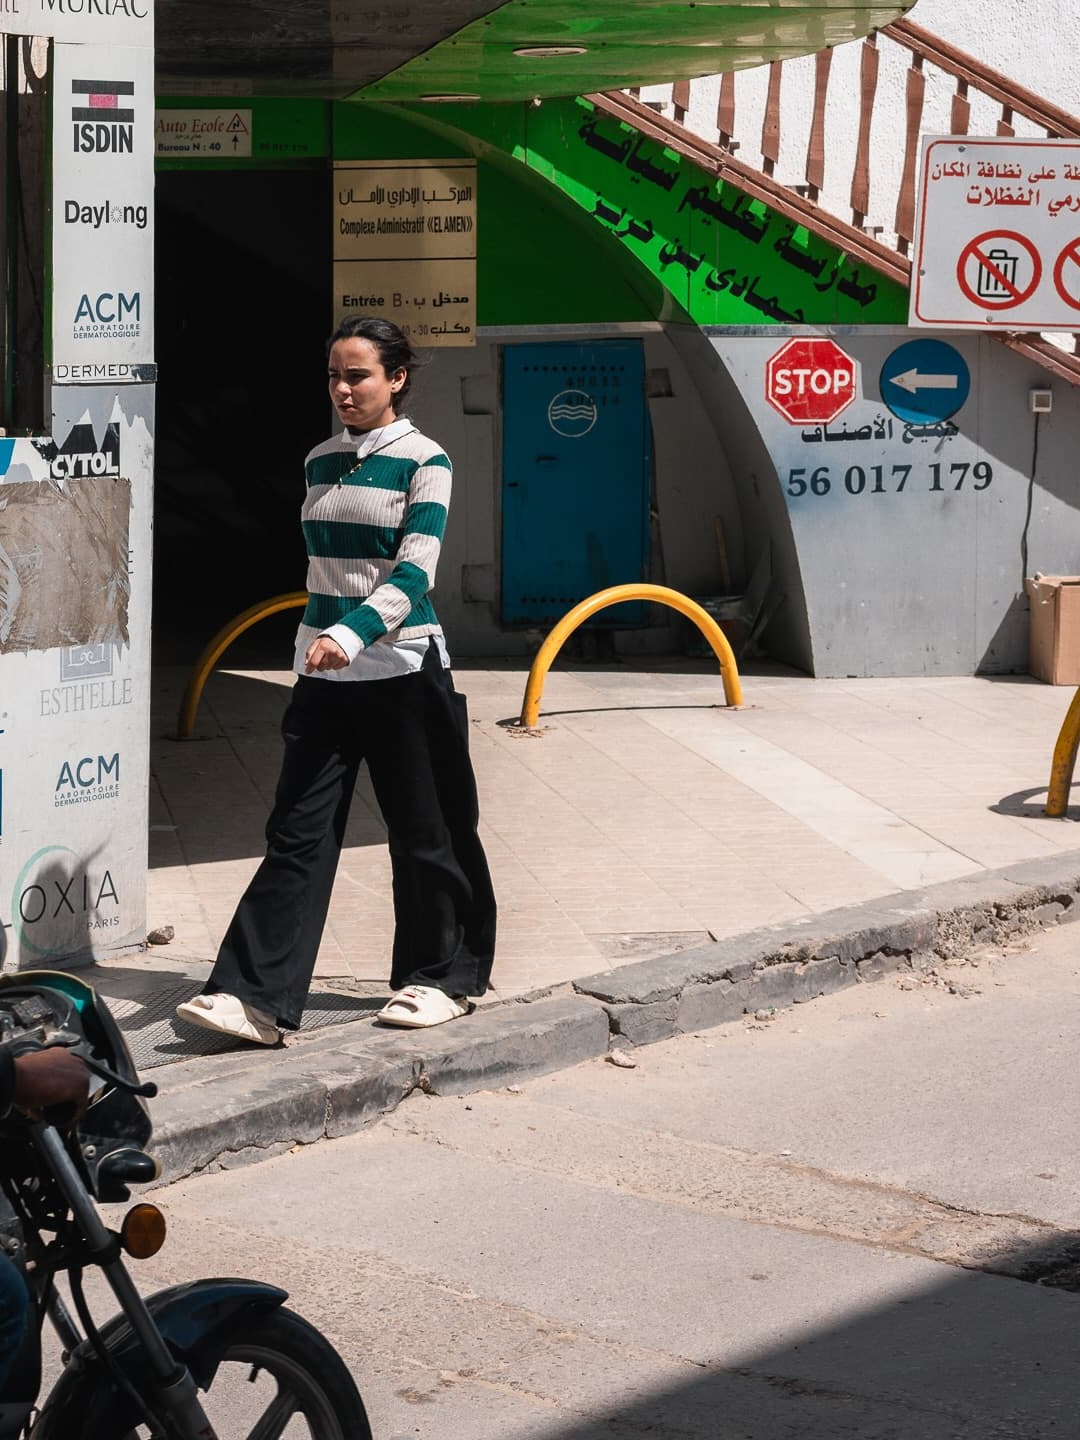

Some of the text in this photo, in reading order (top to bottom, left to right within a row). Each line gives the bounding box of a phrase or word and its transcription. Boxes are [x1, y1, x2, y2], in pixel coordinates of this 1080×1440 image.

[156, 118, 187, 133] Auto
[73, 123, 134, 154] ISDIN
[577, 113, 681, 192] سياقة
[931, 161, 970, 181] المكان
[977, 160, 1023, 179] نظافة
[1027, 165, 1056, 184] على
[421, 186, 472, 205] المركب
[64, 199, 148, 229] Daylong
[339, 217, 375, 239] Complexe
[376, 216, 425, 235] Administratif
[773, 223, 878, 307] مدرسة
[73, 291, 141, 324] ACM
[342, 294, 385, 307] Entrée
[432, 292, 469, 308] مدخل
[73, 323, 141, 332] LABORATOIRE
[73, 330, 141, 339] DERMATOLOGIQUE
[774, 368, 851, 396] STOP
[800, 413, 960, 444] جميع الأصناف
[51, 451, 119, 478] CYTOL
[786, 461, 993, 497] 56 017 179
[55, 752, 120, 792] ACM
[54, 783, 120, 801] LABORATOIRE
[54, 790, 120, 808] DERMATOLOGIQUE
[86, 915, 121, 930] PARIS
